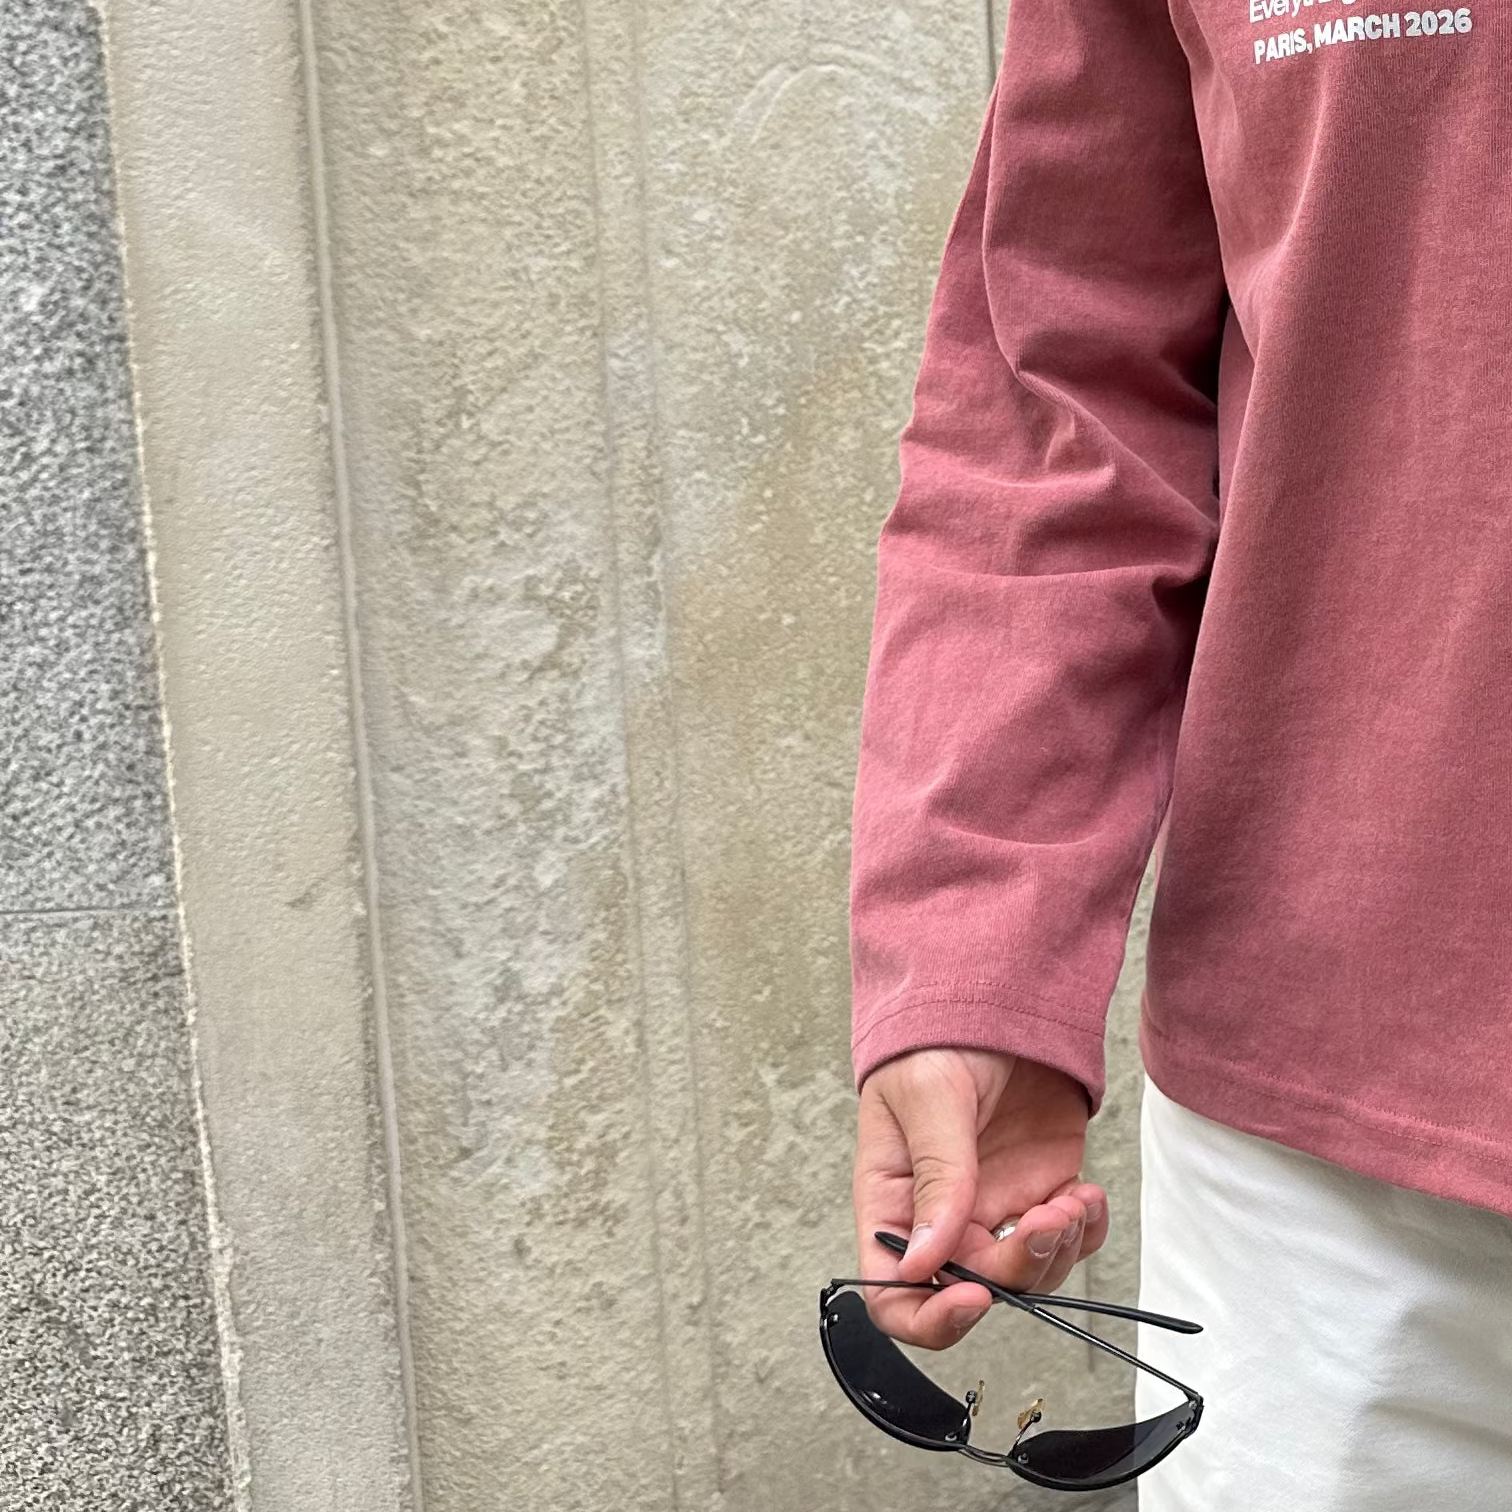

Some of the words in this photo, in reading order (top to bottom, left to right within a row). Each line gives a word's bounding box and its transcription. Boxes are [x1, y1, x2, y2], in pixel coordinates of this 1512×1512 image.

[1253, 27, 1313, 65] PARIS,
[1313, 11, 1401, 49] MARCH
[1403, 7, 1473, 37] 2026
